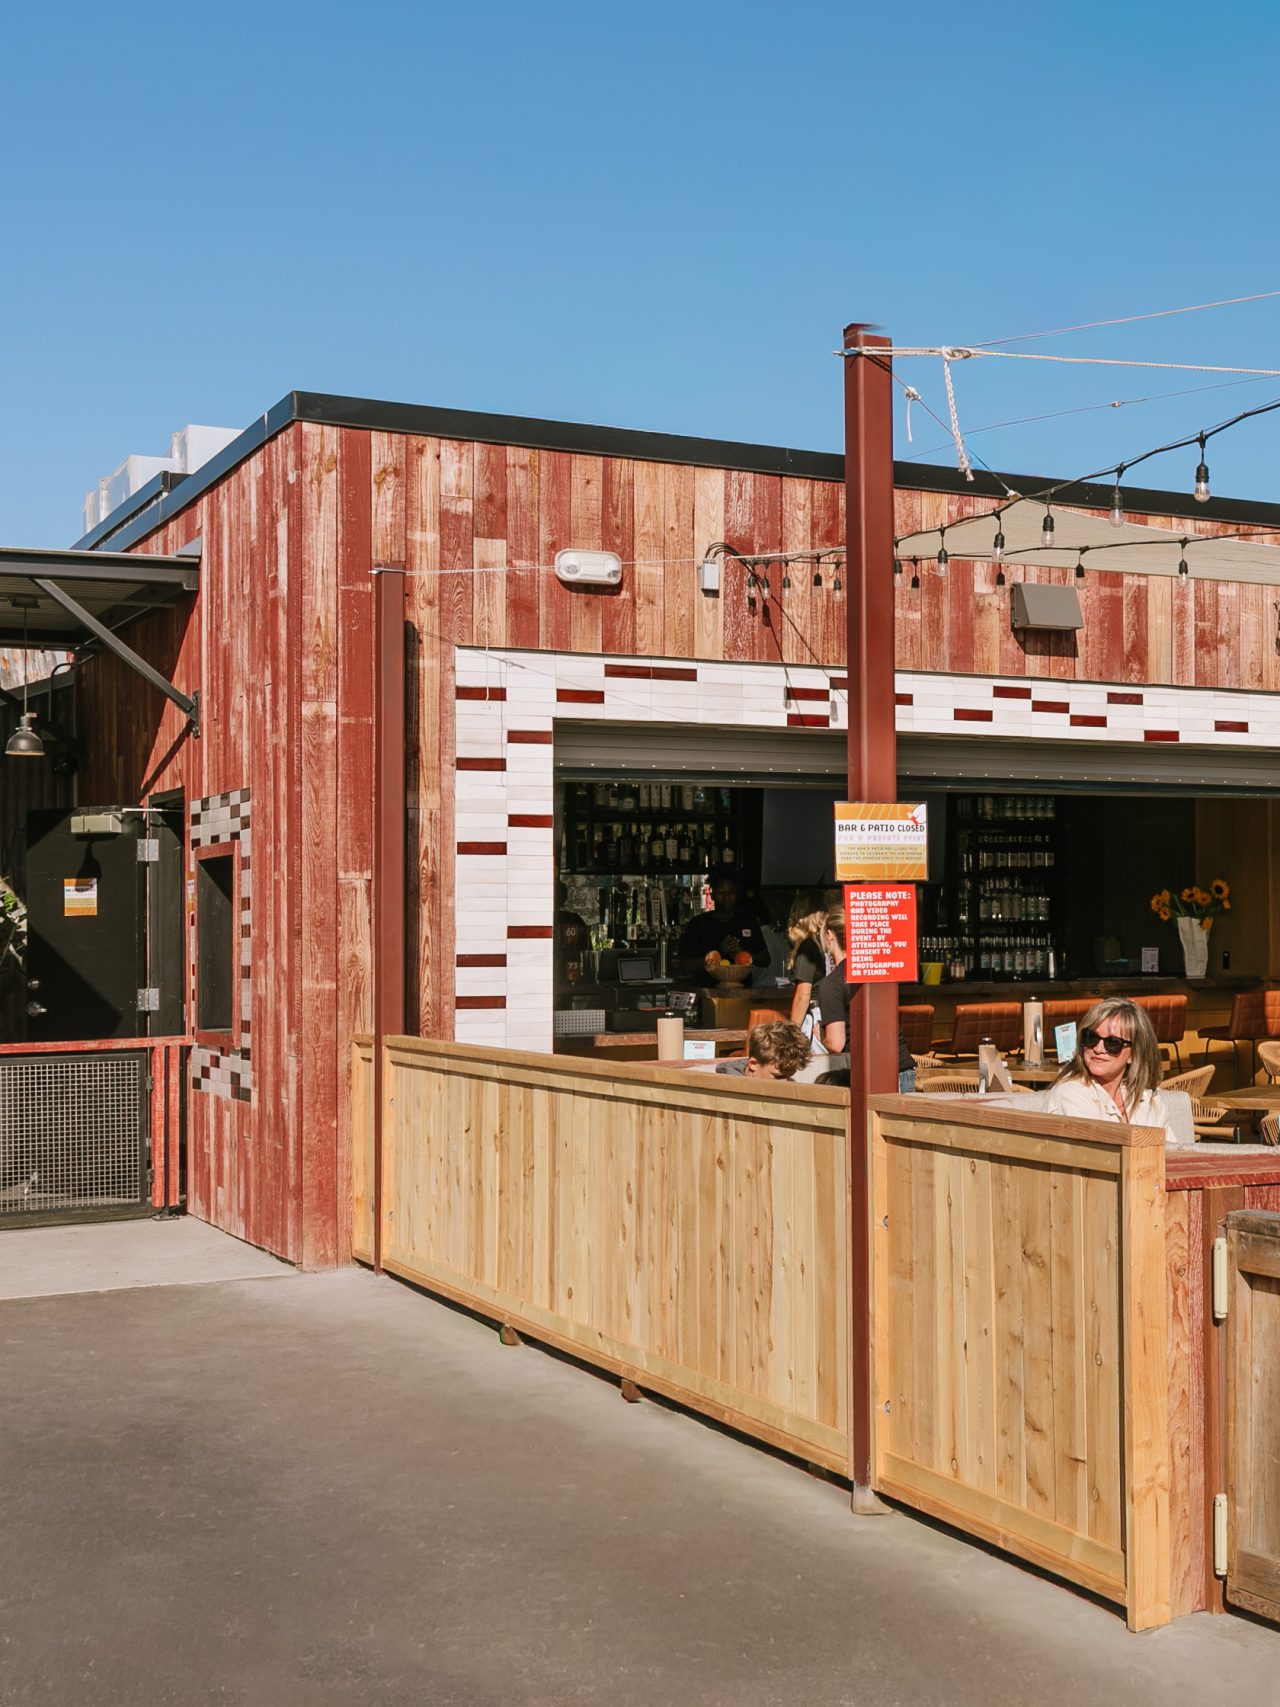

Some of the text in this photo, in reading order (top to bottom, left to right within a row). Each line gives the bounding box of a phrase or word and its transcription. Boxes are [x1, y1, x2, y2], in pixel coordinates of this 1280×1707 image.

[838, 824, 925, 833] BAR & PATIO CLOSED
[904, 834, 925, 842] EVENT
[885, 891, 911, 899] NOTE:
[566, 927, 576, 937] 60
